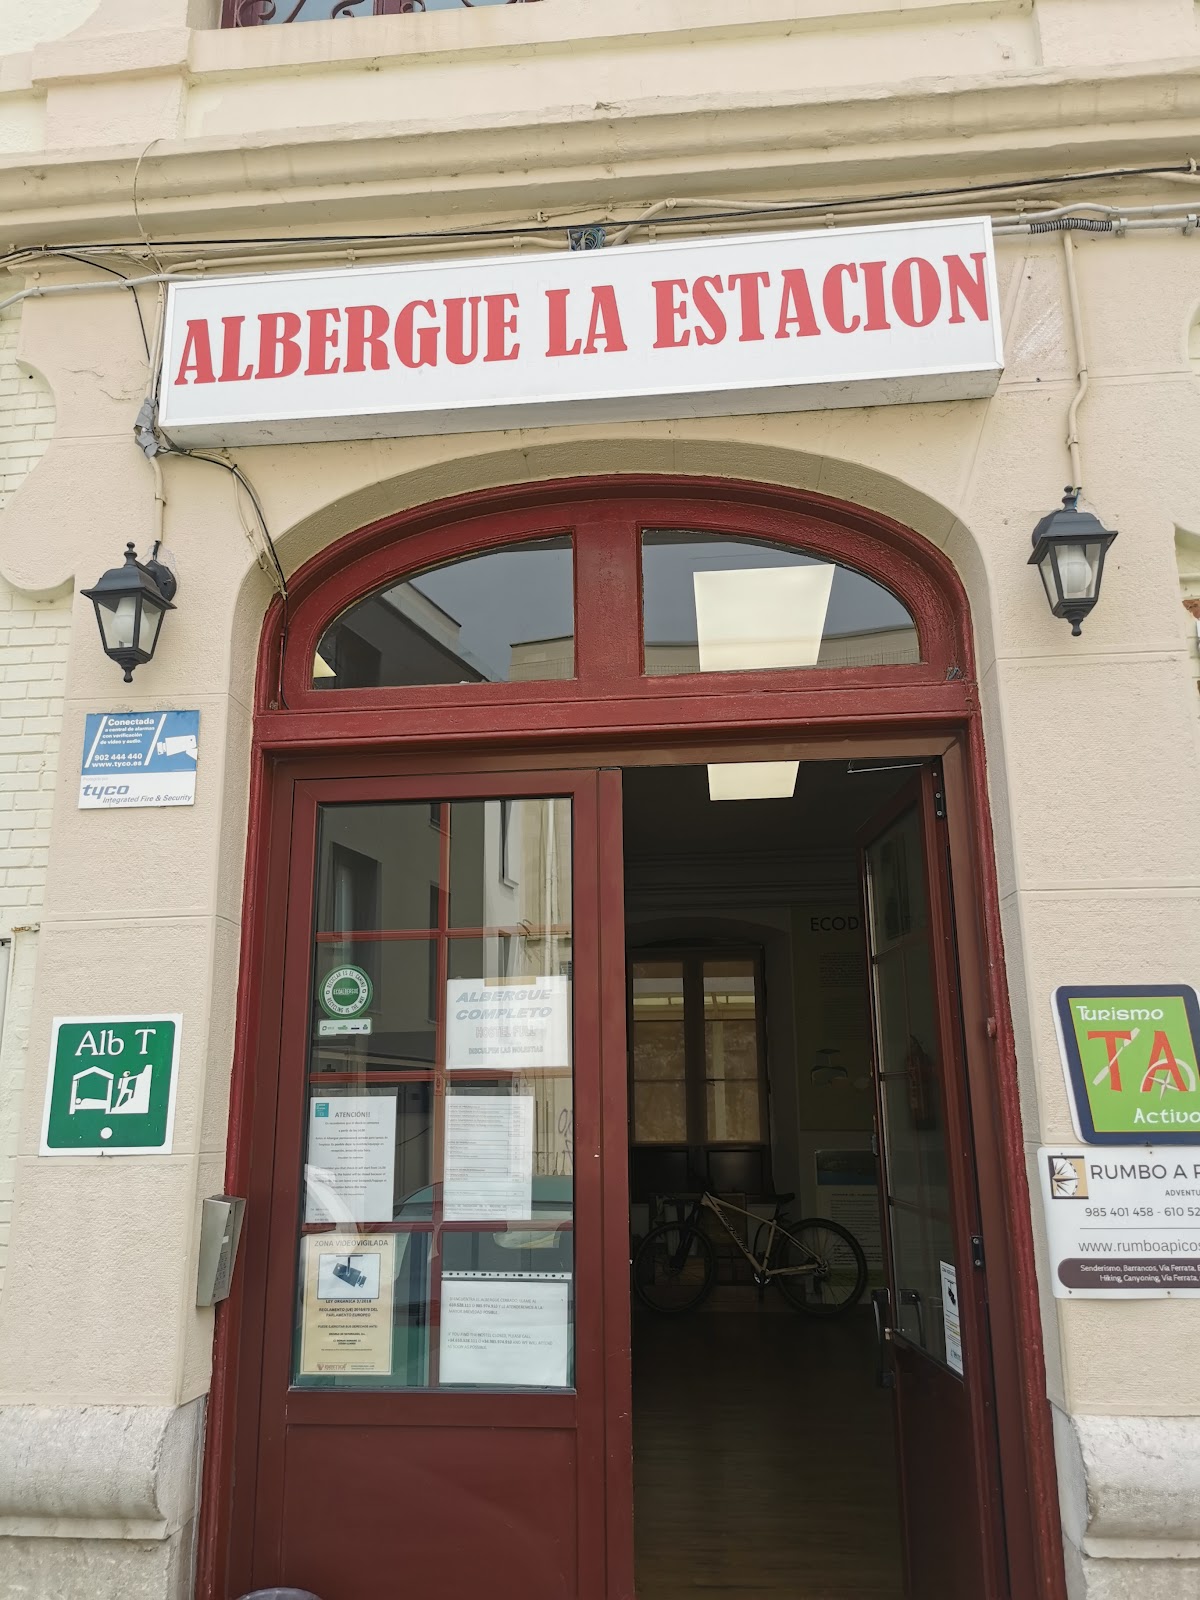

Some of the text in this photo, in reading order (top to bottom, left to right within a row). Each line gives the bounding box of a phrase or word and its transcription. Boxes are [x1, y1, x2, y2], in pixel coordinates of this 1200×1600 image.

[174, 251, 990, 386] ALBERGUE LA ESTACION
[108, 718, 154, 726] Conectada
[82, 784, 130, 799] tyco
[102, 796, 140, 804] Integrated
[163, 793, 192, 803] Security
[456, 990, 552, 1002] ALBERGUE
[456, 1007, 552, 1020] COMPLETO
[1076, 1006, 1164, 1020] Turismo
[476, 1026, 536, 1038] HOSTEL FULL
[74, 1029, 156, 1056] Alb T
[1134, 1108, 1200, 1124] Activo
[1090, 1164, 1167, 1179] RUMBO
[1174, 1164, 1188, 1179] A
[1085, 1207, 1106, 1217] 985
[1110, 1207, 1129, 1216] 401
[1133, 1207, 1153, 1216] 458
[1164, 1207, 1184, 1216] 610
[1080, 1264, 1122, 1272] Senderismo,
[1100, 1275, 1122, 1283] Hiking,
[1123, 1275, 1161, 1283] Canyoning,
